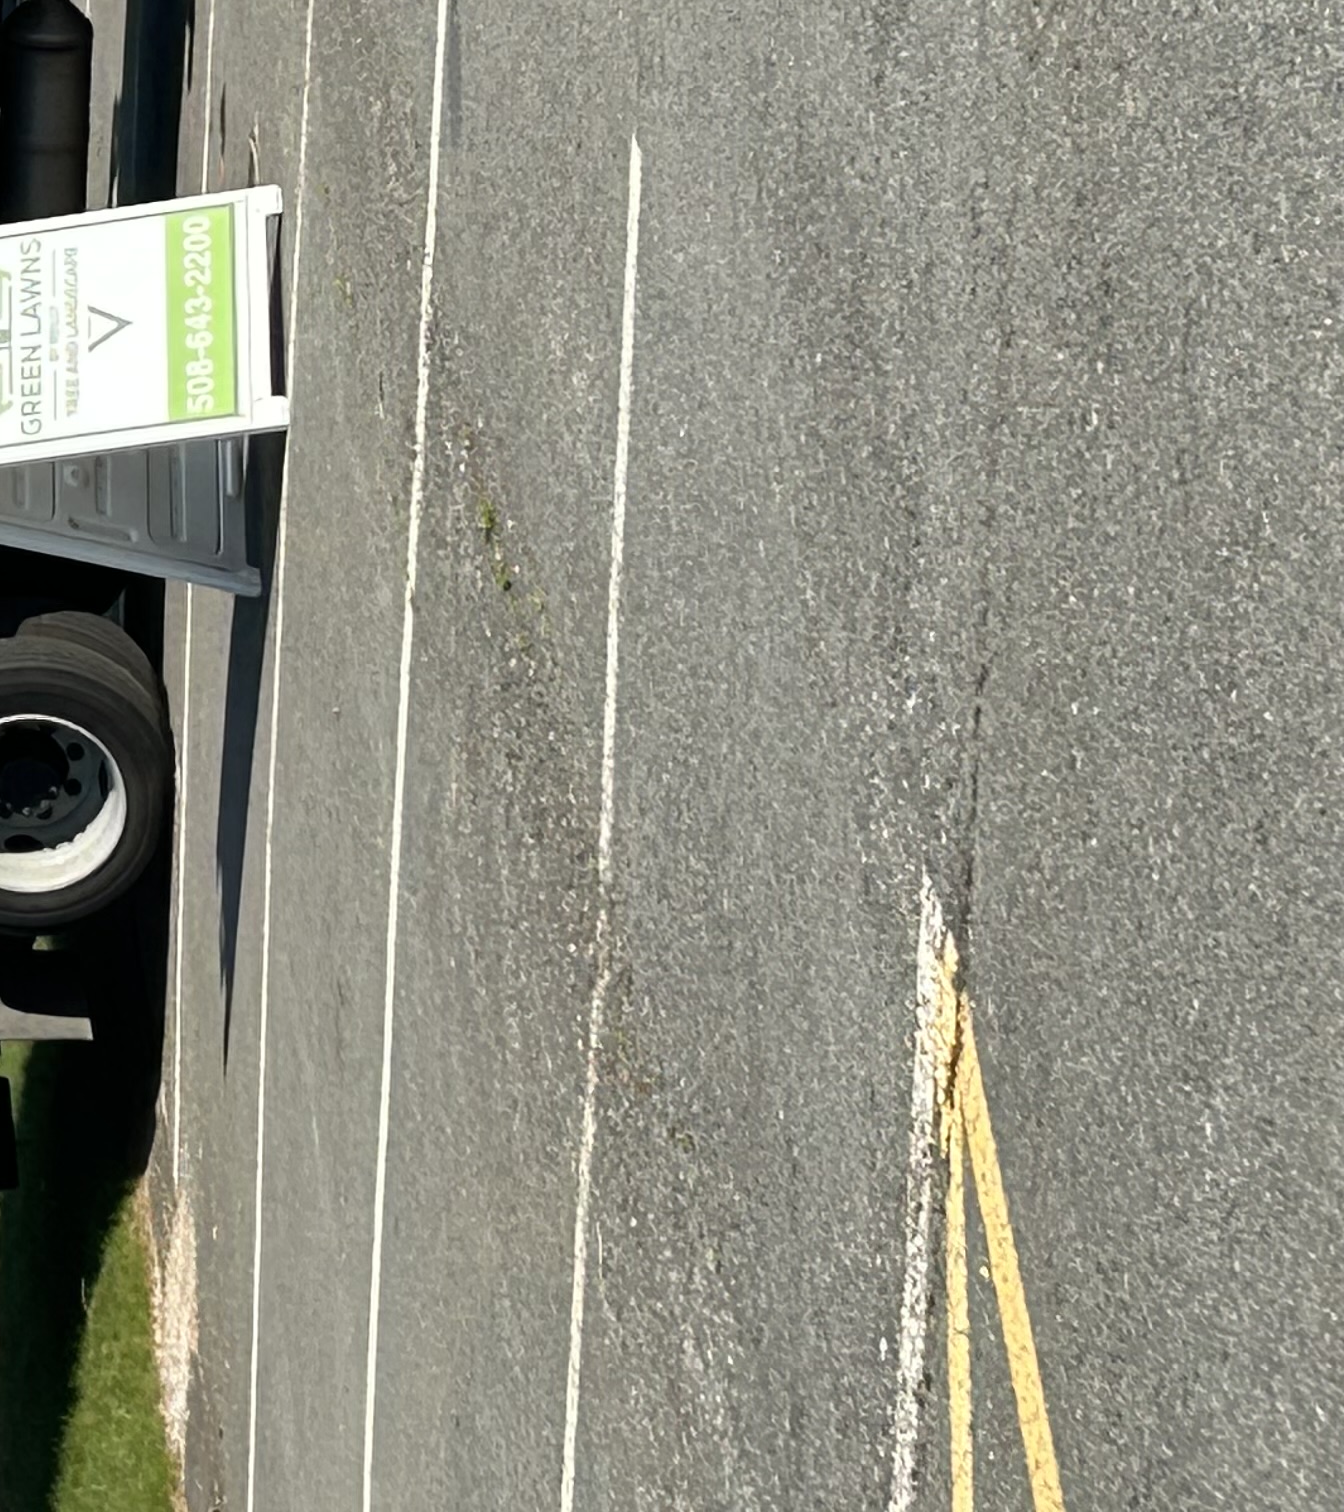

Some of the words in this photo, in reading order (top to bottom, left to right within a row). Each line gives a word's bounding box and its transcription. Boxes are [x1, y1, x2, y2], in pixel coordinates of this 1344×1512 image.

[19, 237, 43, 337] LAWNS
[182, 214, 216, 414] 508-643-2200
[20, 343, 43, 435] GREEN
